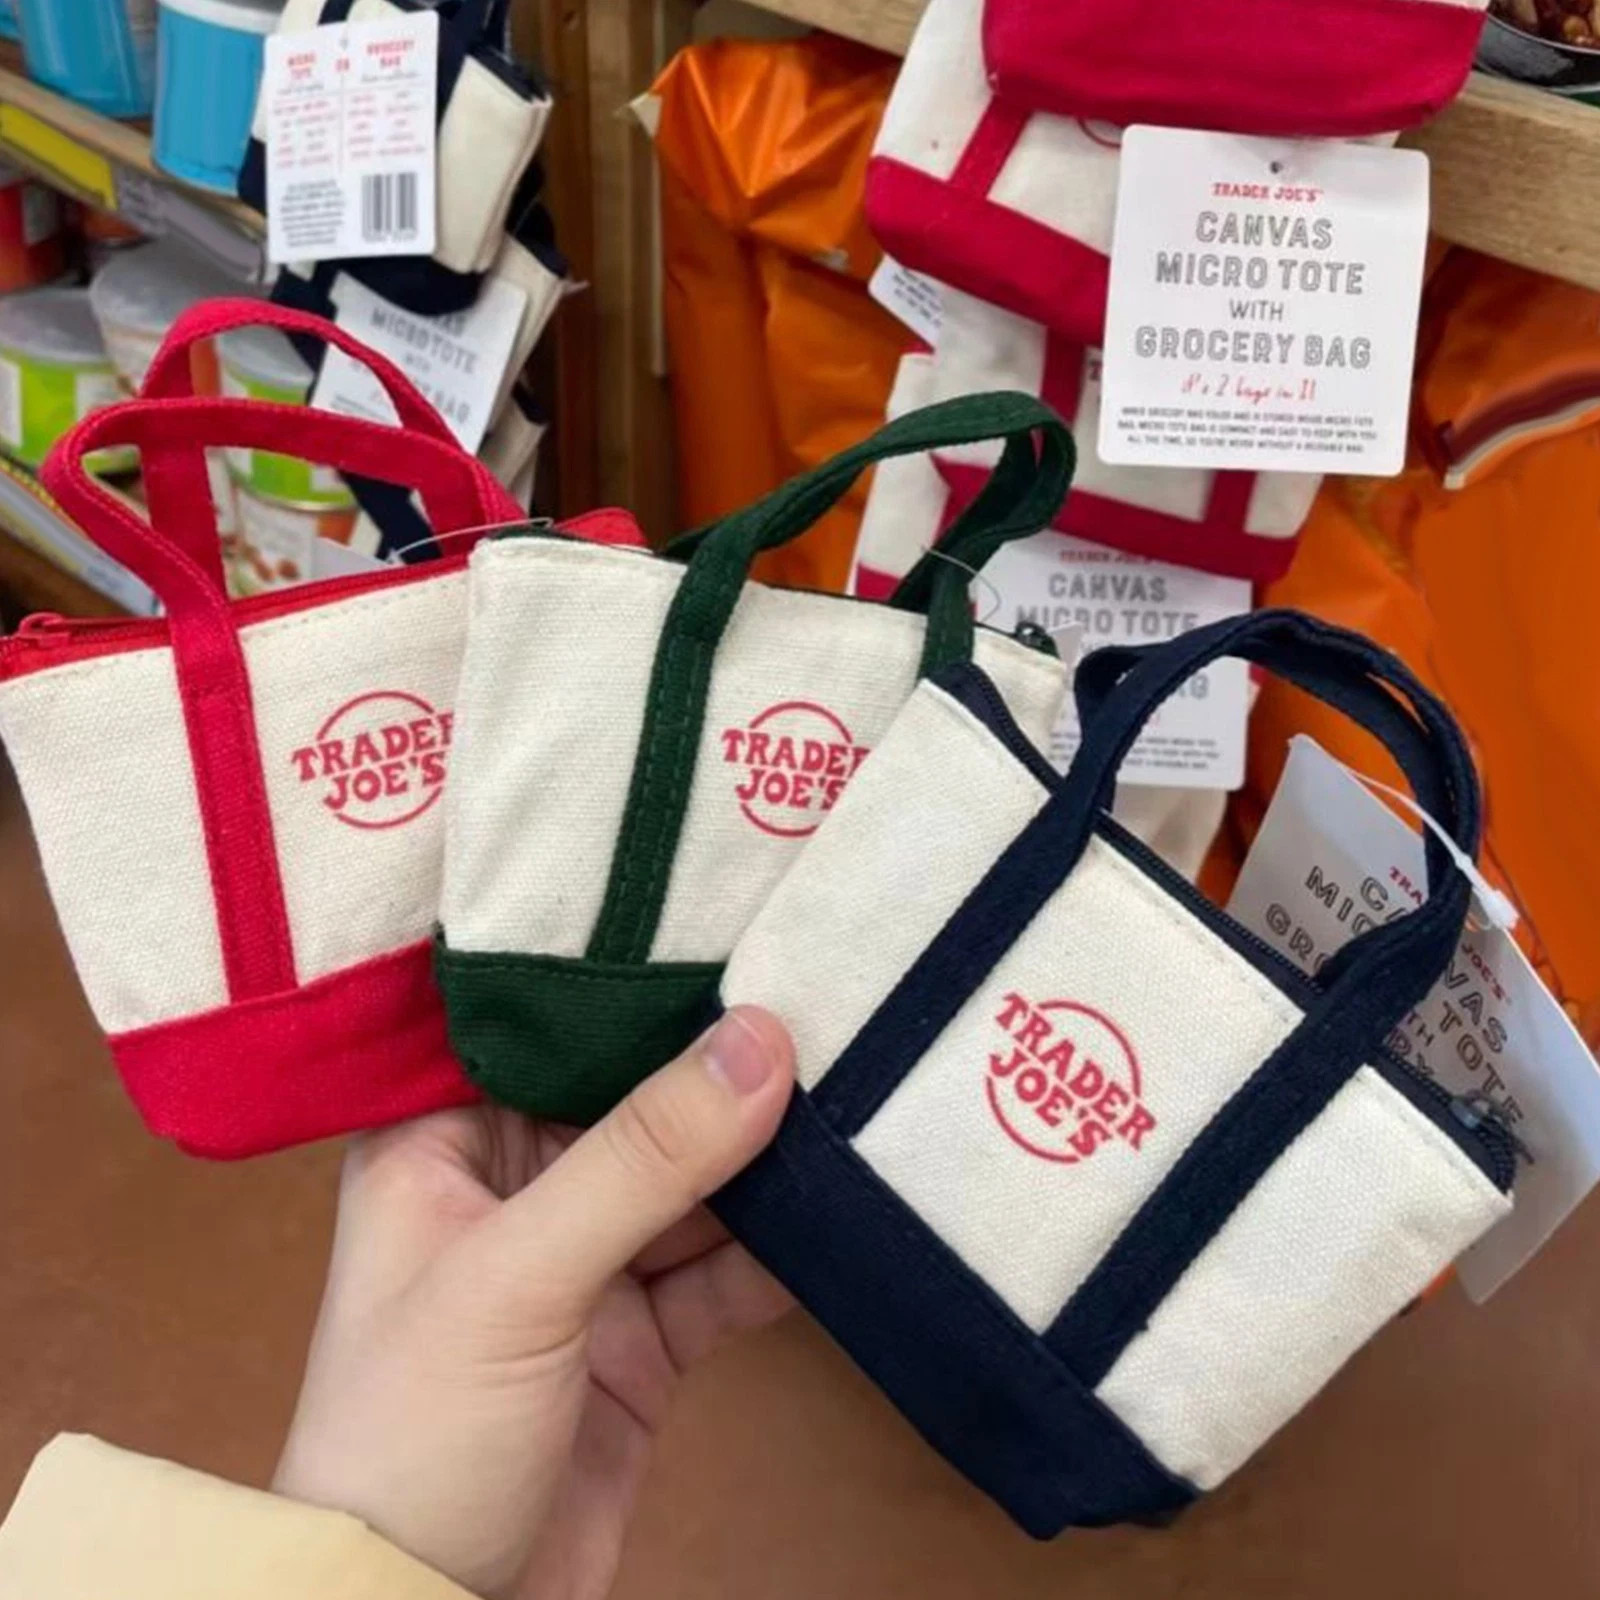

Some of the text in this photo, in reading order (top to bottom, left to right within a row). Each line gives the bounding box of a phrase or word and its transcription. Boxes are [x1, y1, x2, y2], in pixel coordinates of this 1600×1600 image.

[1213, 182, 1270, 200] TRADER
[1196, 210, 1333, 250] CANVAS
[1155, 251, 1366, 295] MICRO TOTE
[1229, 300, 1284, 322] WITH
[370, 307, 430, 350] MICRO
[431, 332, 478, 375] TOTE
[1135, 325, 1372, 370] GROCERY BAG
[1049, 573, 1168, 602] CANVAS
[323, 750, 447, 810] JOE'S
[995, 992, 1158, 1152] TRADER
[989, 1047, 1113, 1157] JOE'S
